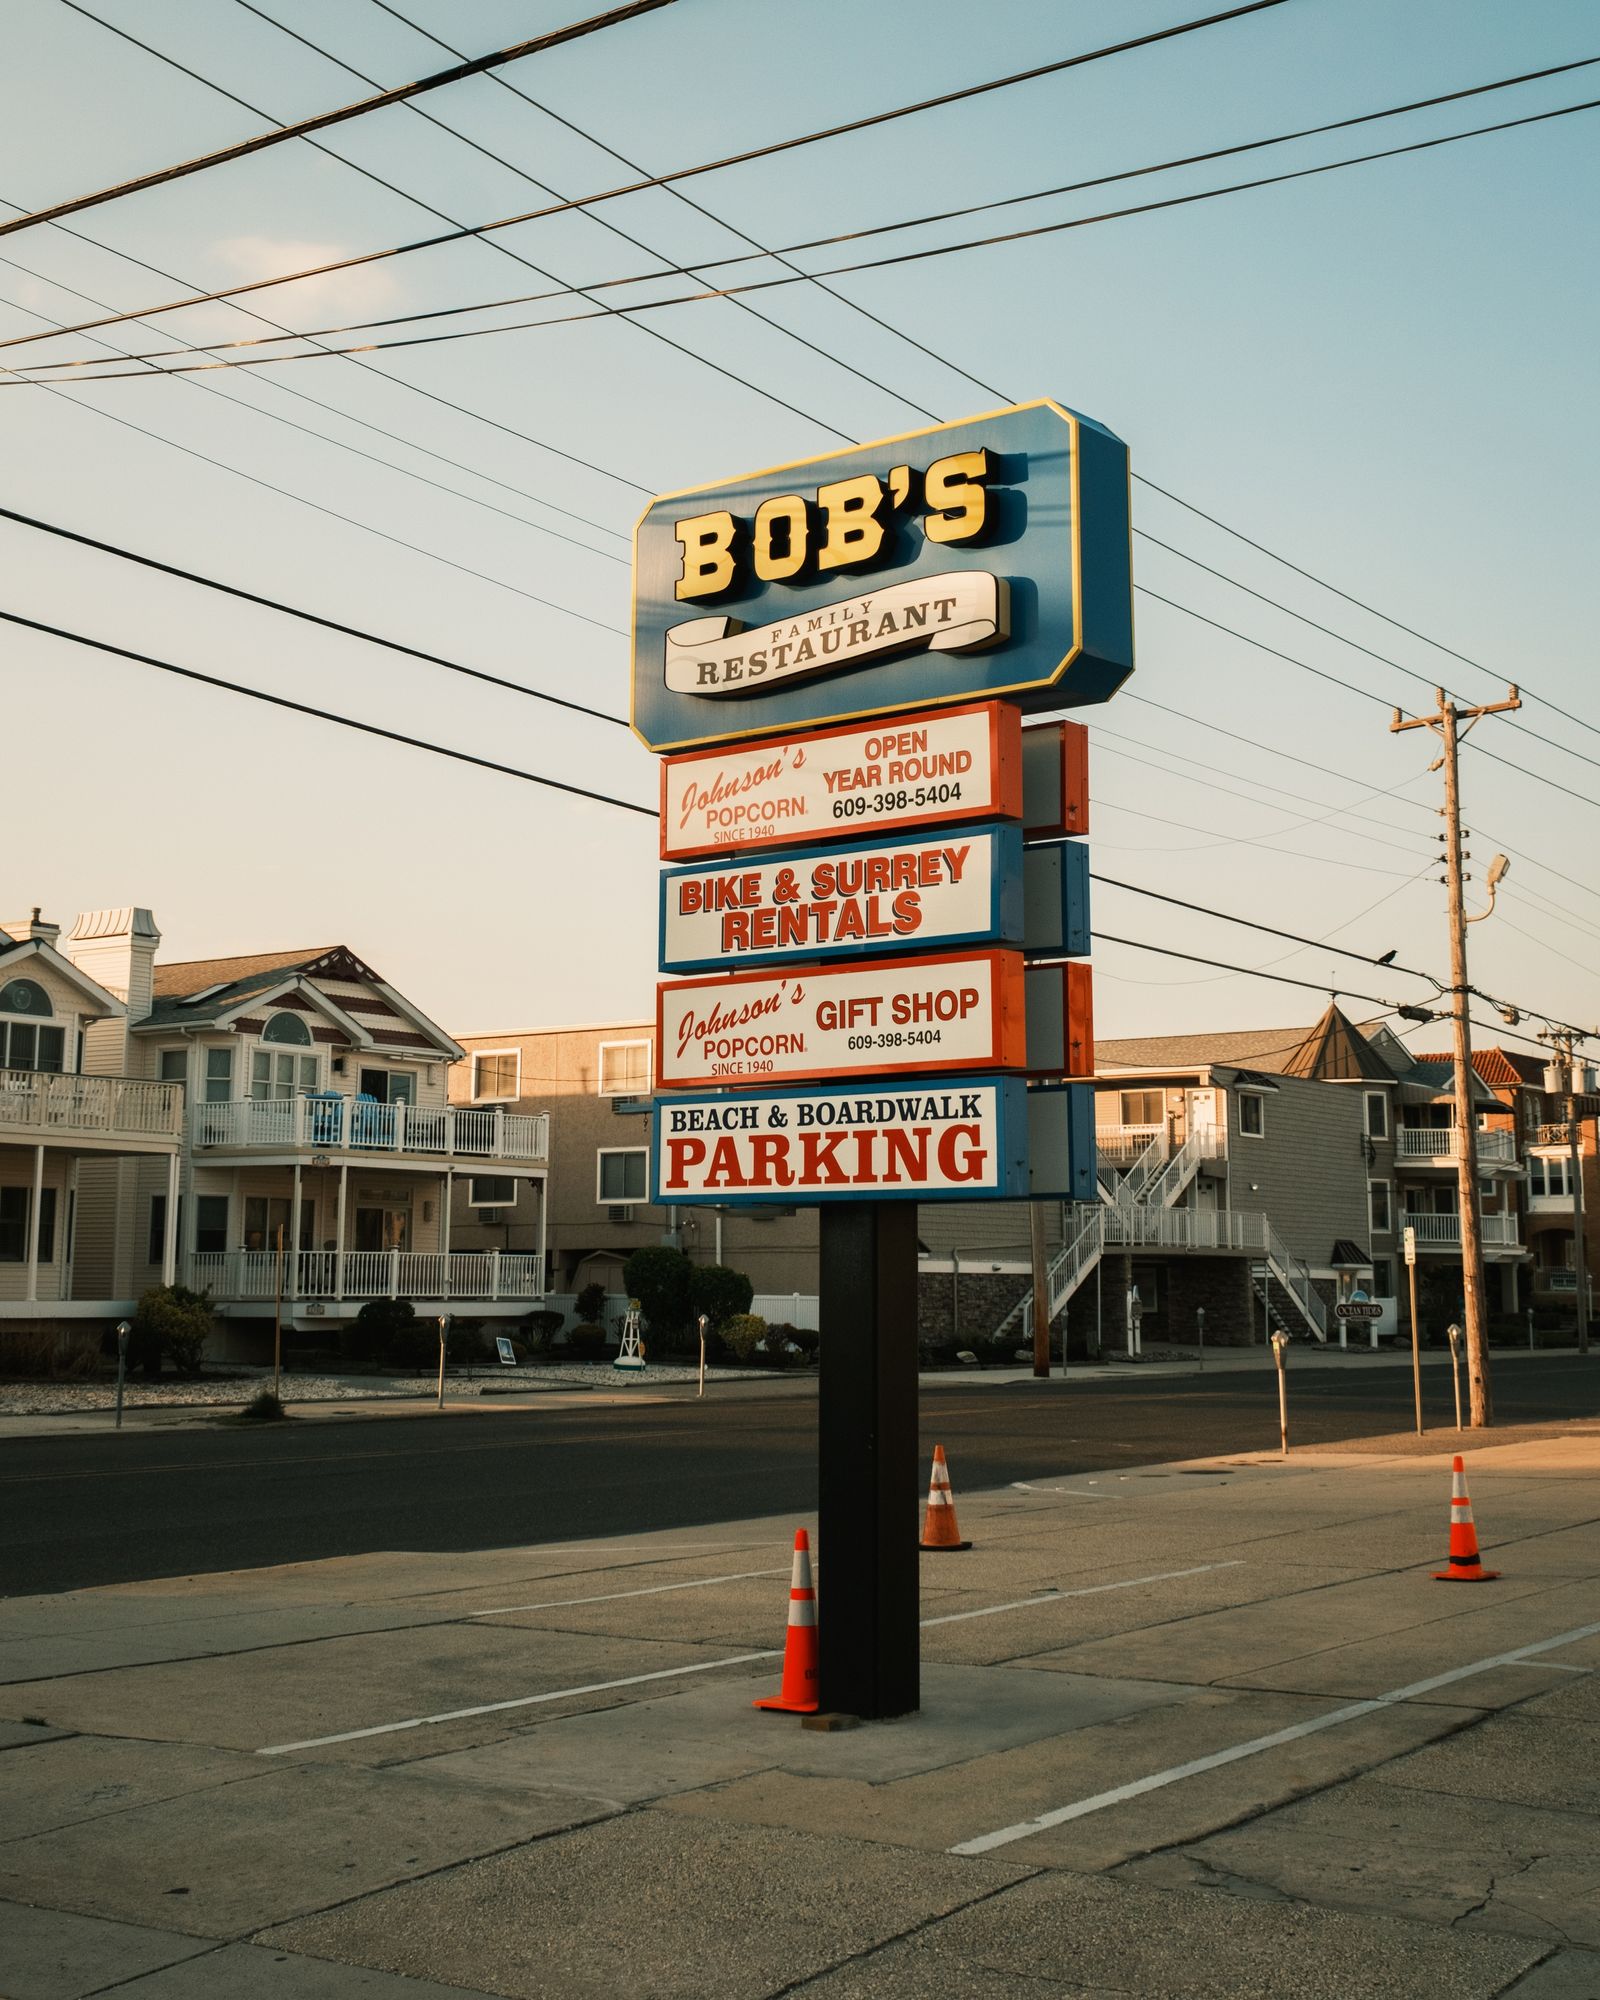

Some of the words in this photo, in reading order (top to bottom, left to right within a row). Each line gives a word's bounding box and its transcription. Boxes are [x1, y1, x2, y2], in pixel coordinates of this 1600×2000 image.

[674, 446, 989, 602] BOB'S
[696, 597, 957, 686] RESTAURANT
[771, 600, 873, 644] FAMILY
[864, 729, 928, 761] OPEN
[679, 746, 807, 830] Johnson's
[823, 765, 882, 794] YEAR
[889, 750, 973, 781] ROUND
[832, 782, 962, 819] 609-398-5404
[713, 828, 745, 844] SINCE
[749, 824, 775, 839] 1940
[679, 872, 763, 916] BIKE
[772, 867, 802, 905] &
[811, 845, 971, 899] SURREY
[721, 891, 923, 953] RENTALS
[676, 979, 806, 1059] Johnson's
[816, 997, 883, 1031] GIFT
[891, 988, 980, 1024] SHOP
[847, 1029, 942, 1050] 609-398-5404
[711, 1061, 743, 1075] SINCE
[747, 1059, 774, 1073] 1940
[670, 1106, 760, 1132] BEACH
[767, 1104, 789, 1128] &
[796, 1094, 982, 1126] BOARDWALK
[665, 1124, 988, 1189] PARKING
